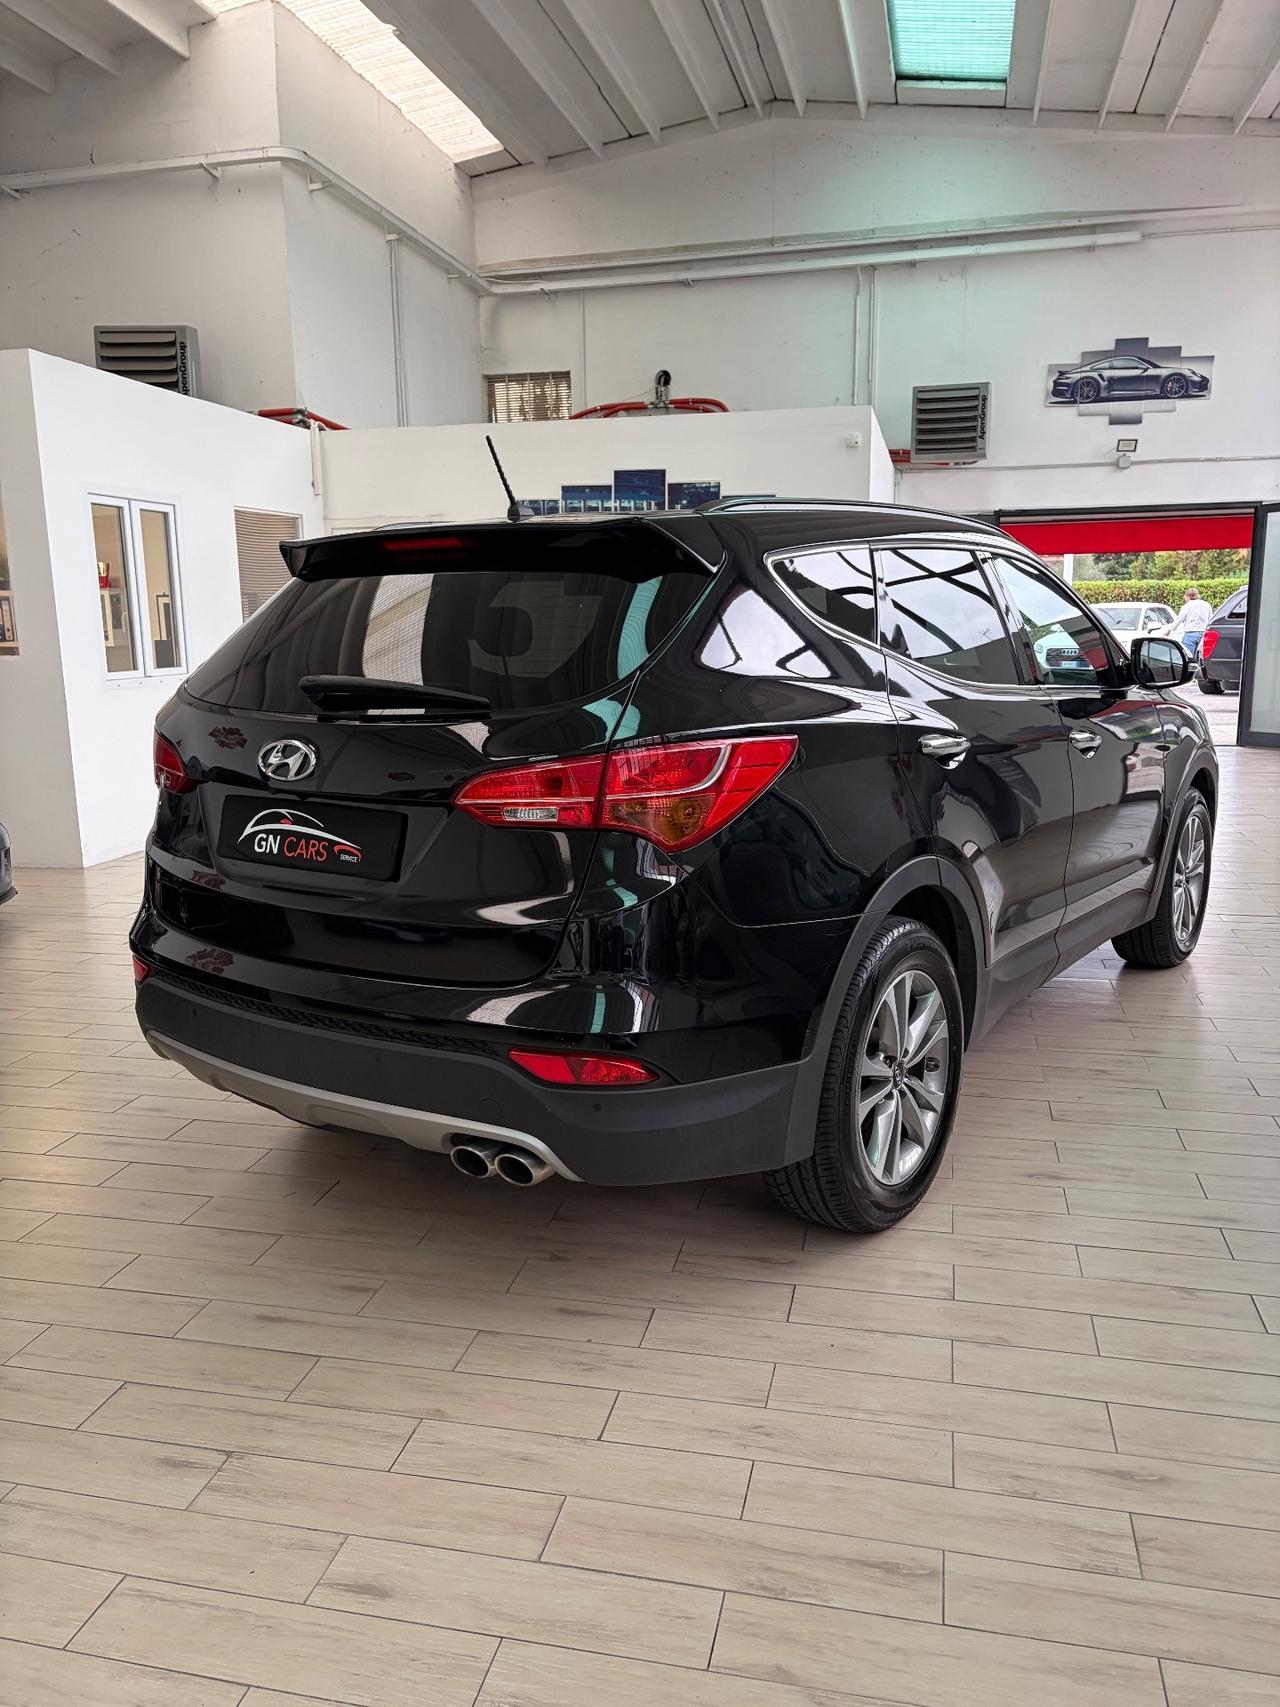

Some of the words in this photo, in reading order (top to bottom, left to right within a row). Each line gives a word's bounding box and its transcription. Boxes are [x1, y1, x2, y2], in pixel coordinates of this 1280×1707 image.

[978, 394, 988, 440] ApenGroup
[254, 833, 281, 854] GN
[283, 836, 329, 861] CARS
